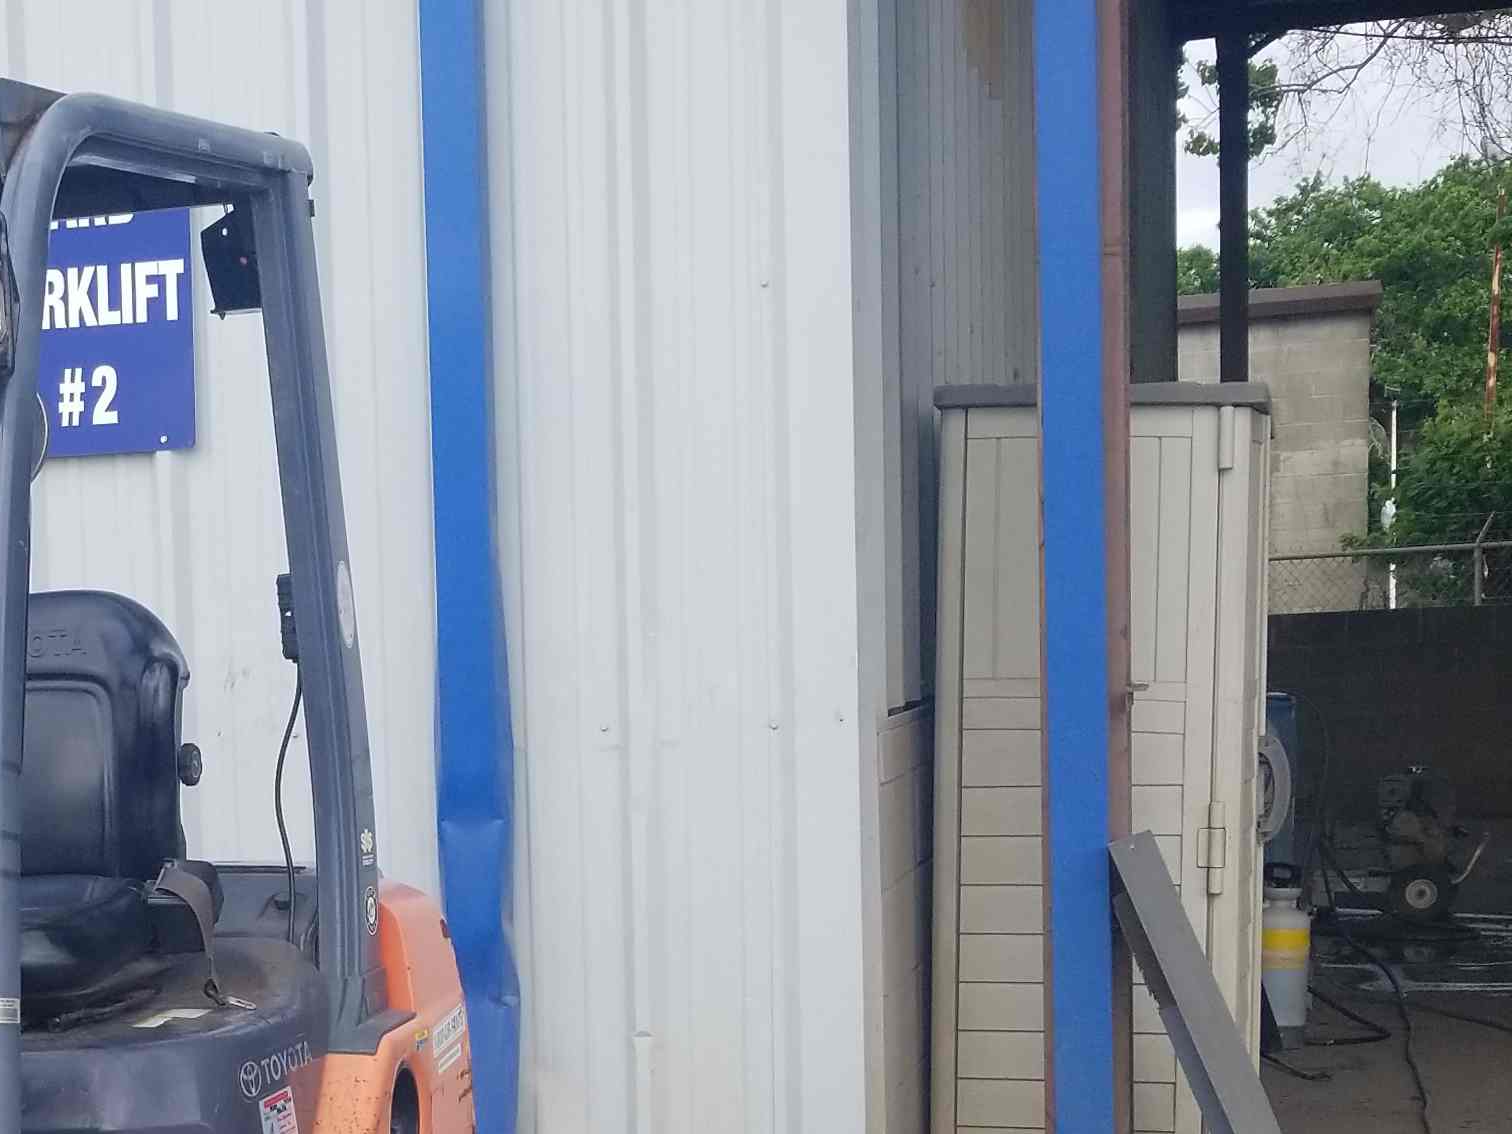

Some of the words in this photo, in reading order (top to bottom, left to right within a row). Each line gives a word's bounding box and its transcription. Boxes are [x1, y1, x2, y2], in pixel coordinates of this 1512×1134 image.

[41, 259, 184, 329] RKLIFT
[58, 365, 119, 427] #2
[261, 1041, 313, 1082] TOYOTA
